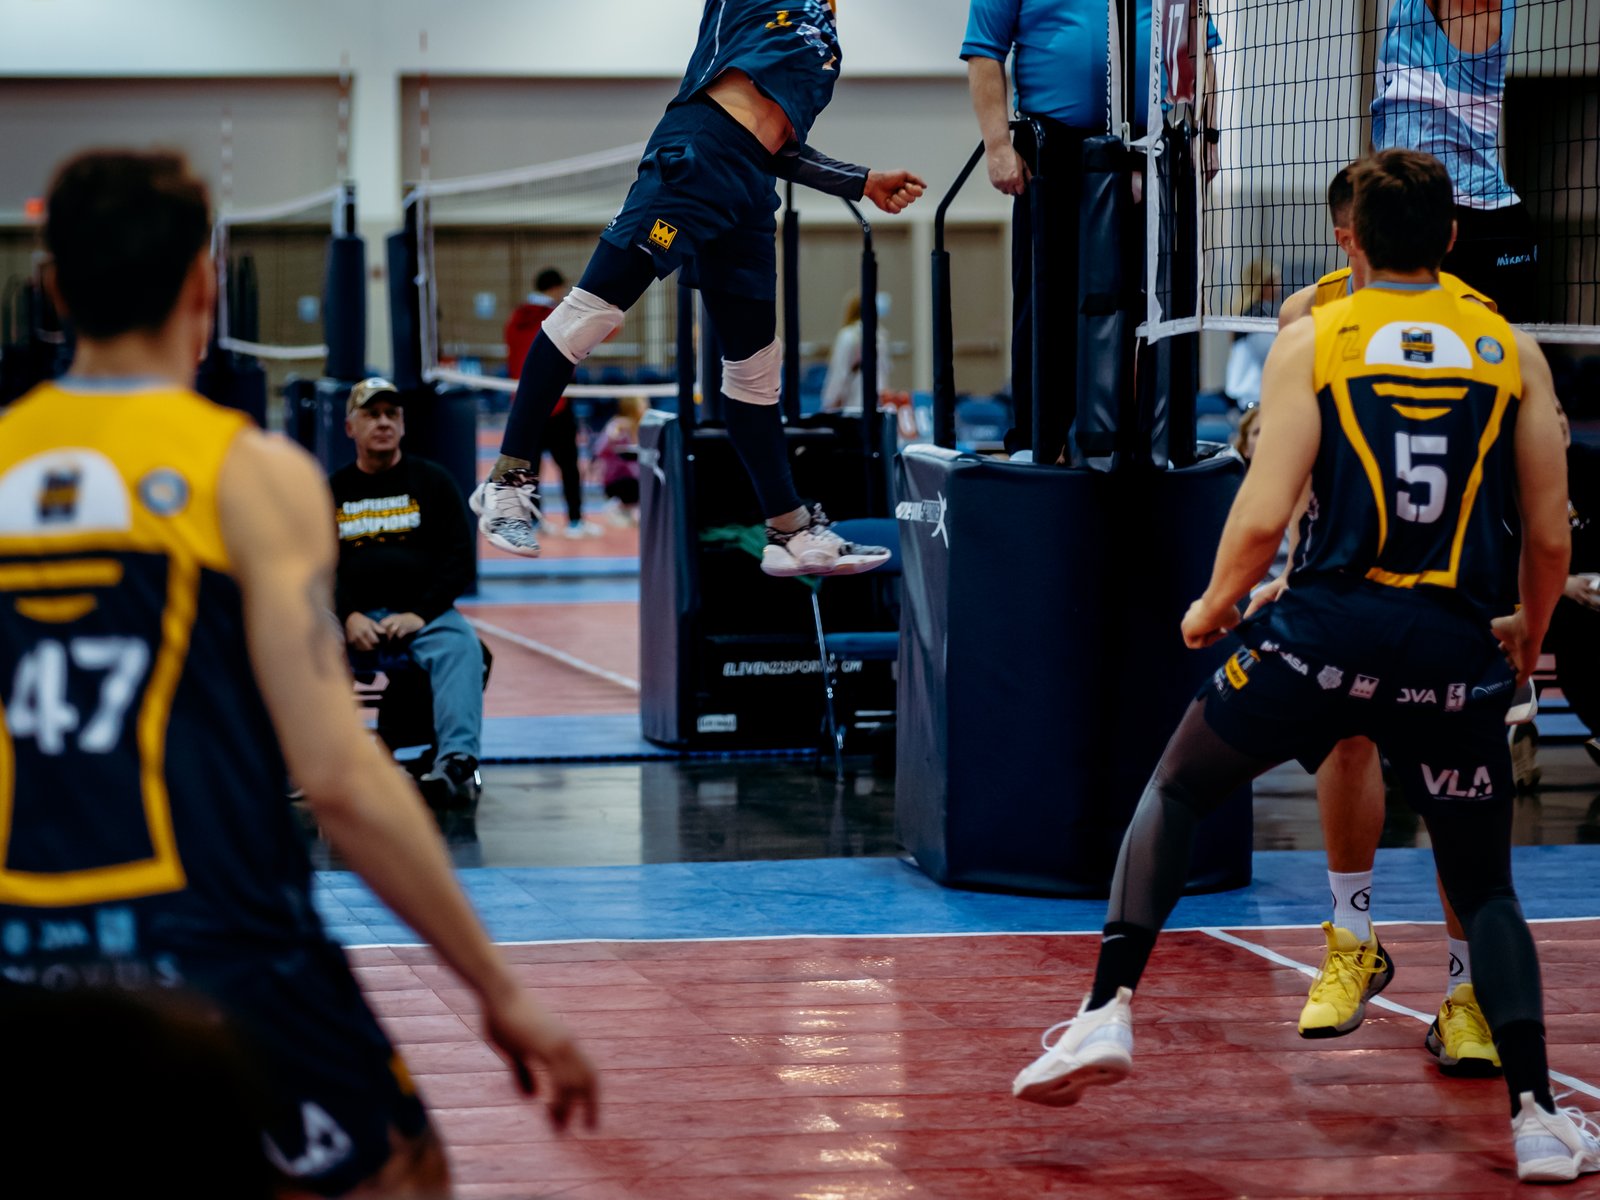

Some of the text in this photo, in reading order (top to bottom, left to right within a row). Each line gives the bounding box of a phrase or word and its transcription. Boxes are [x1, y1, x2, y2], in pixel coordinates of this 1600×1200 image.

[1395, 430, 1449, 524] 5
[7, 636, 151, 756] 47
[1420, 763, 1494, 799] VLA
